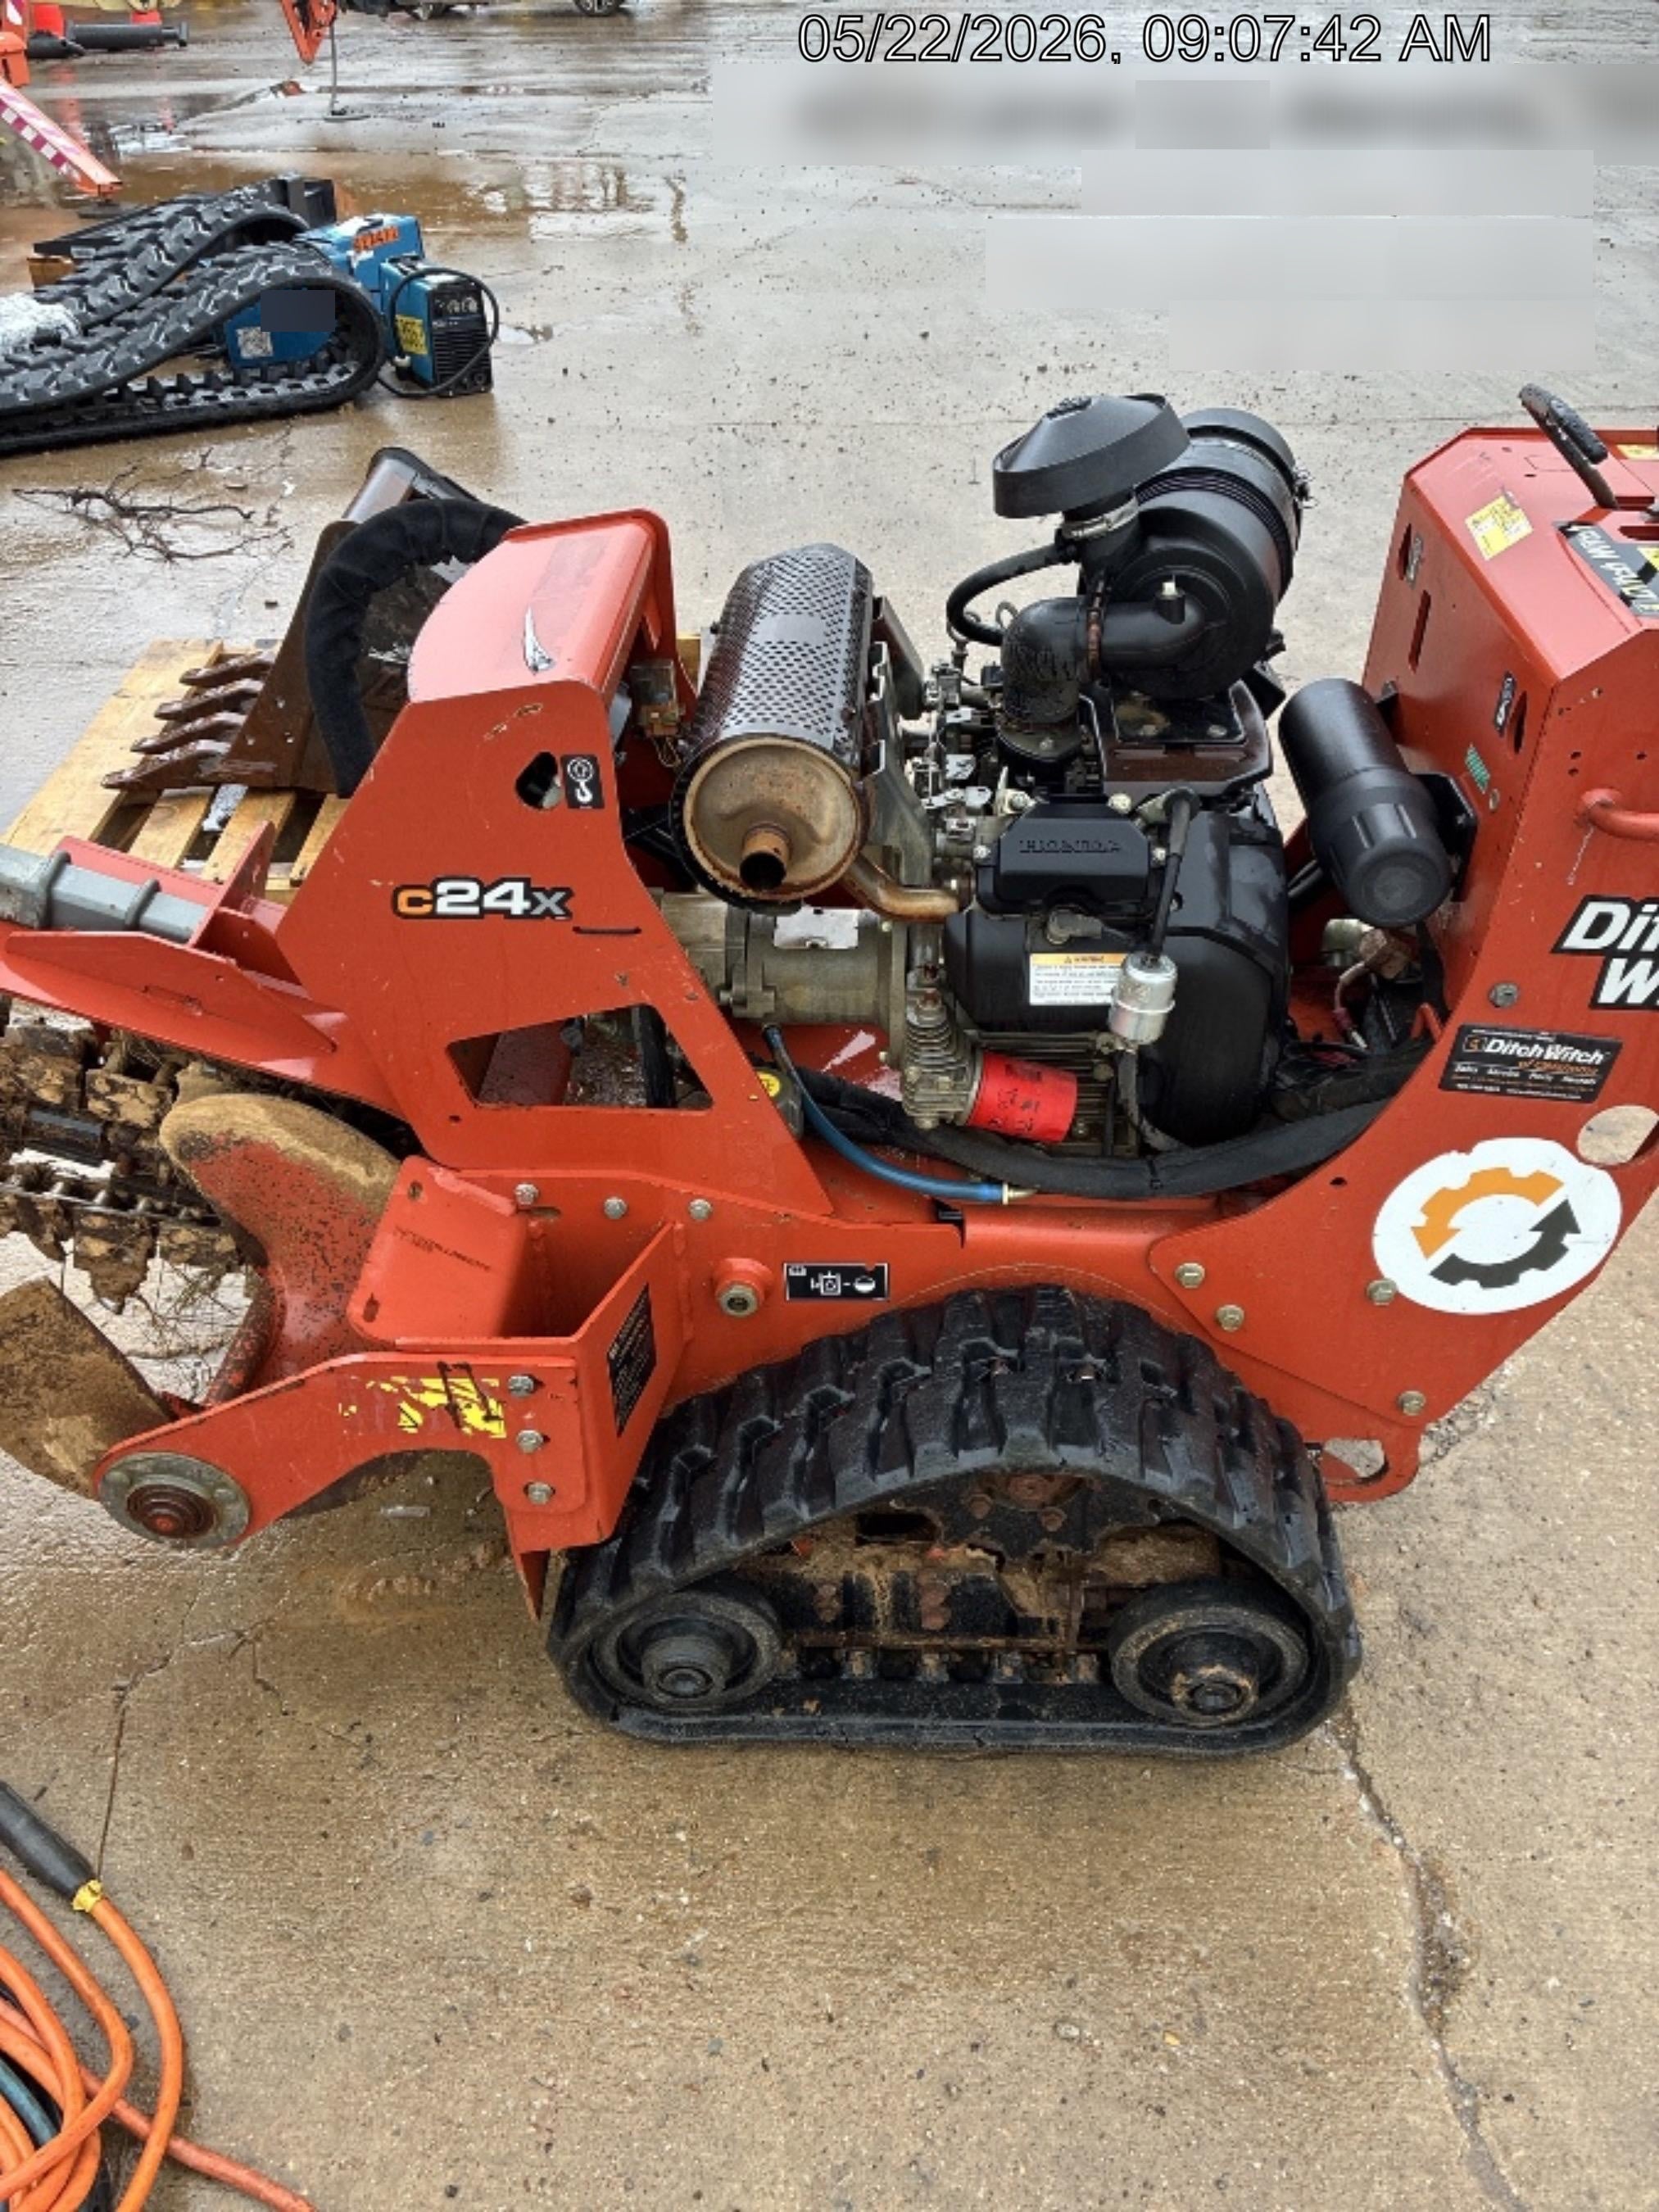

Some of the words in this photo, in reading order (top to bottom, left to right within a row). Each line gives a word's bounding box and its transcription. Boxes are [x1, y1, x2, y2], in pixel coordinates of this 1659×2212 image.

[1019, 839, 1122, 854] HONDA
[1597, 957, 1659, 1005] W
[1484, 1038, 1543, 1058] Ditch
[1543, 1044, 1605, 1065] Witch
